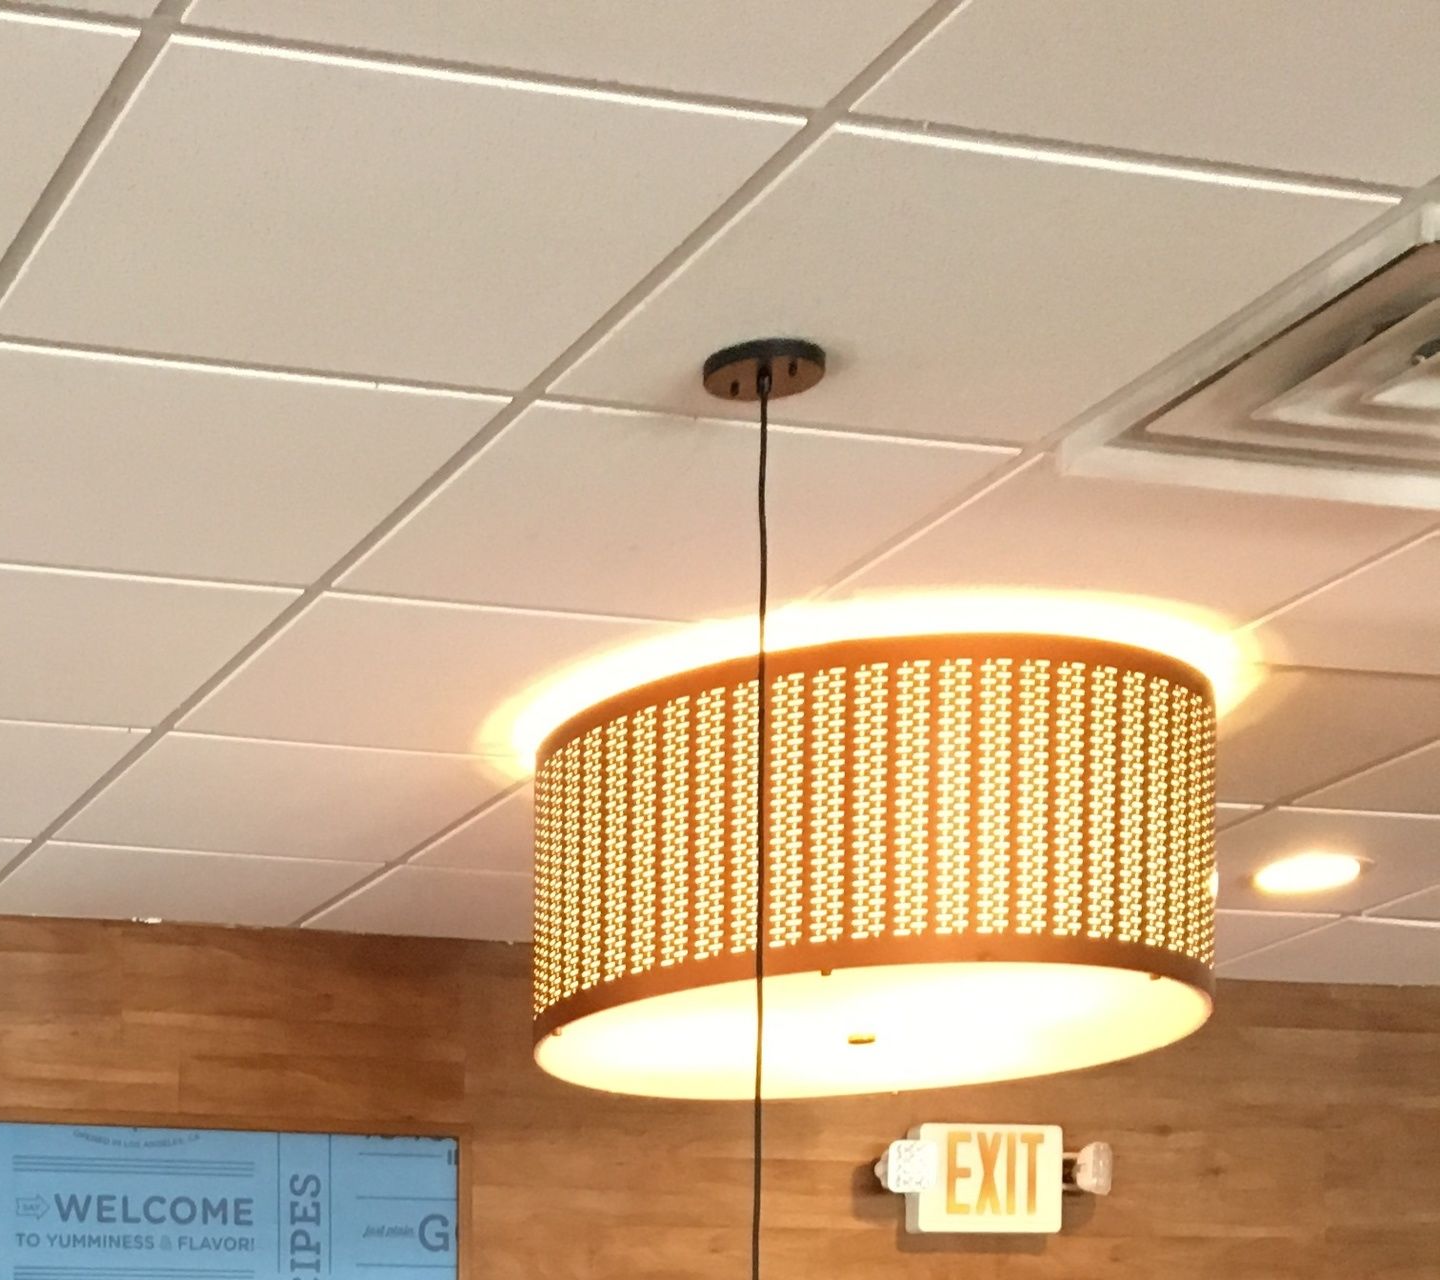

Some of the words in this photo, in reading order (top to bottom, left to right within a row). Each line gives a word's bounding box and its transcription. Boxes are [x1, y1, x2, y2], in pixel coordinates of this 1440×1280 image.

[946, 1131, 1045, 1216] EXIT
[54, 1193, 254, 1226] WELCOME
[16, 1233, 40, 1248] TO
[46, 1233, 154, 1250] YUMMINESS
[178, 1236, 255, 1252] FLAVOR!
